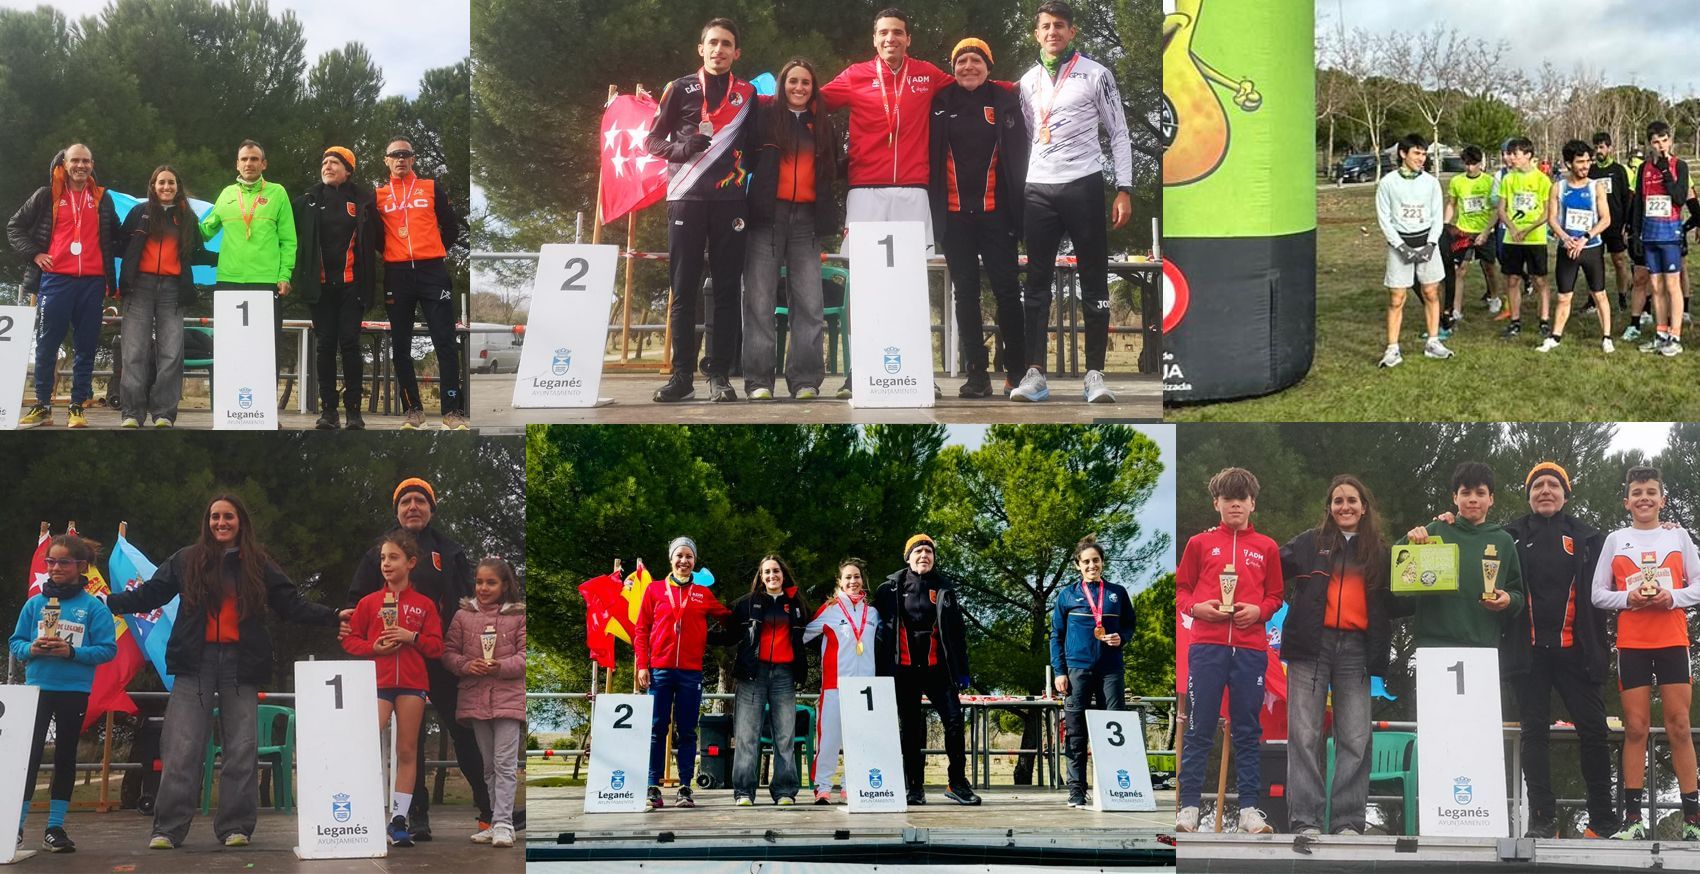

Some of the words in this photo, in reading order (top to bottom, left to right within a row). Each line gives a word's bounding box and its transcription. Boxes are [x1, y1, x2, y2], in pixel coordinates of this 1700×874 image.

[912, 75, 930, 83] ADM
[1649, 201, 1667, 211] 222
[1571, 214, 1589, 225] 172
[877, 234, 895, 268] 1
[560, 257, 590, 291] 2
[236, 300, 249, 327] 1
[533, 377, 582, 390] Leganés
[869, 375, 917, 389] Leganés
[227, 409, 265, 421] Leganés
[1447, 660, 1465, 695] 1
[325, 674, 344, 710] 1
[860, 686, 874, 711] 1
[613, 703, 634, 729] 2
[1105, 721, 1126, 747] 3
[598, 790, 634, 800] Leganés
[859, 789, 894, 799] Leganés
[1109, 789, 1143, 798] Leganés
[1437, 806, 1490, 820] Leganés
[317, 823, 368, 838] Leganés
[318, 837, 369, 845] AYUNTAMIENTO
